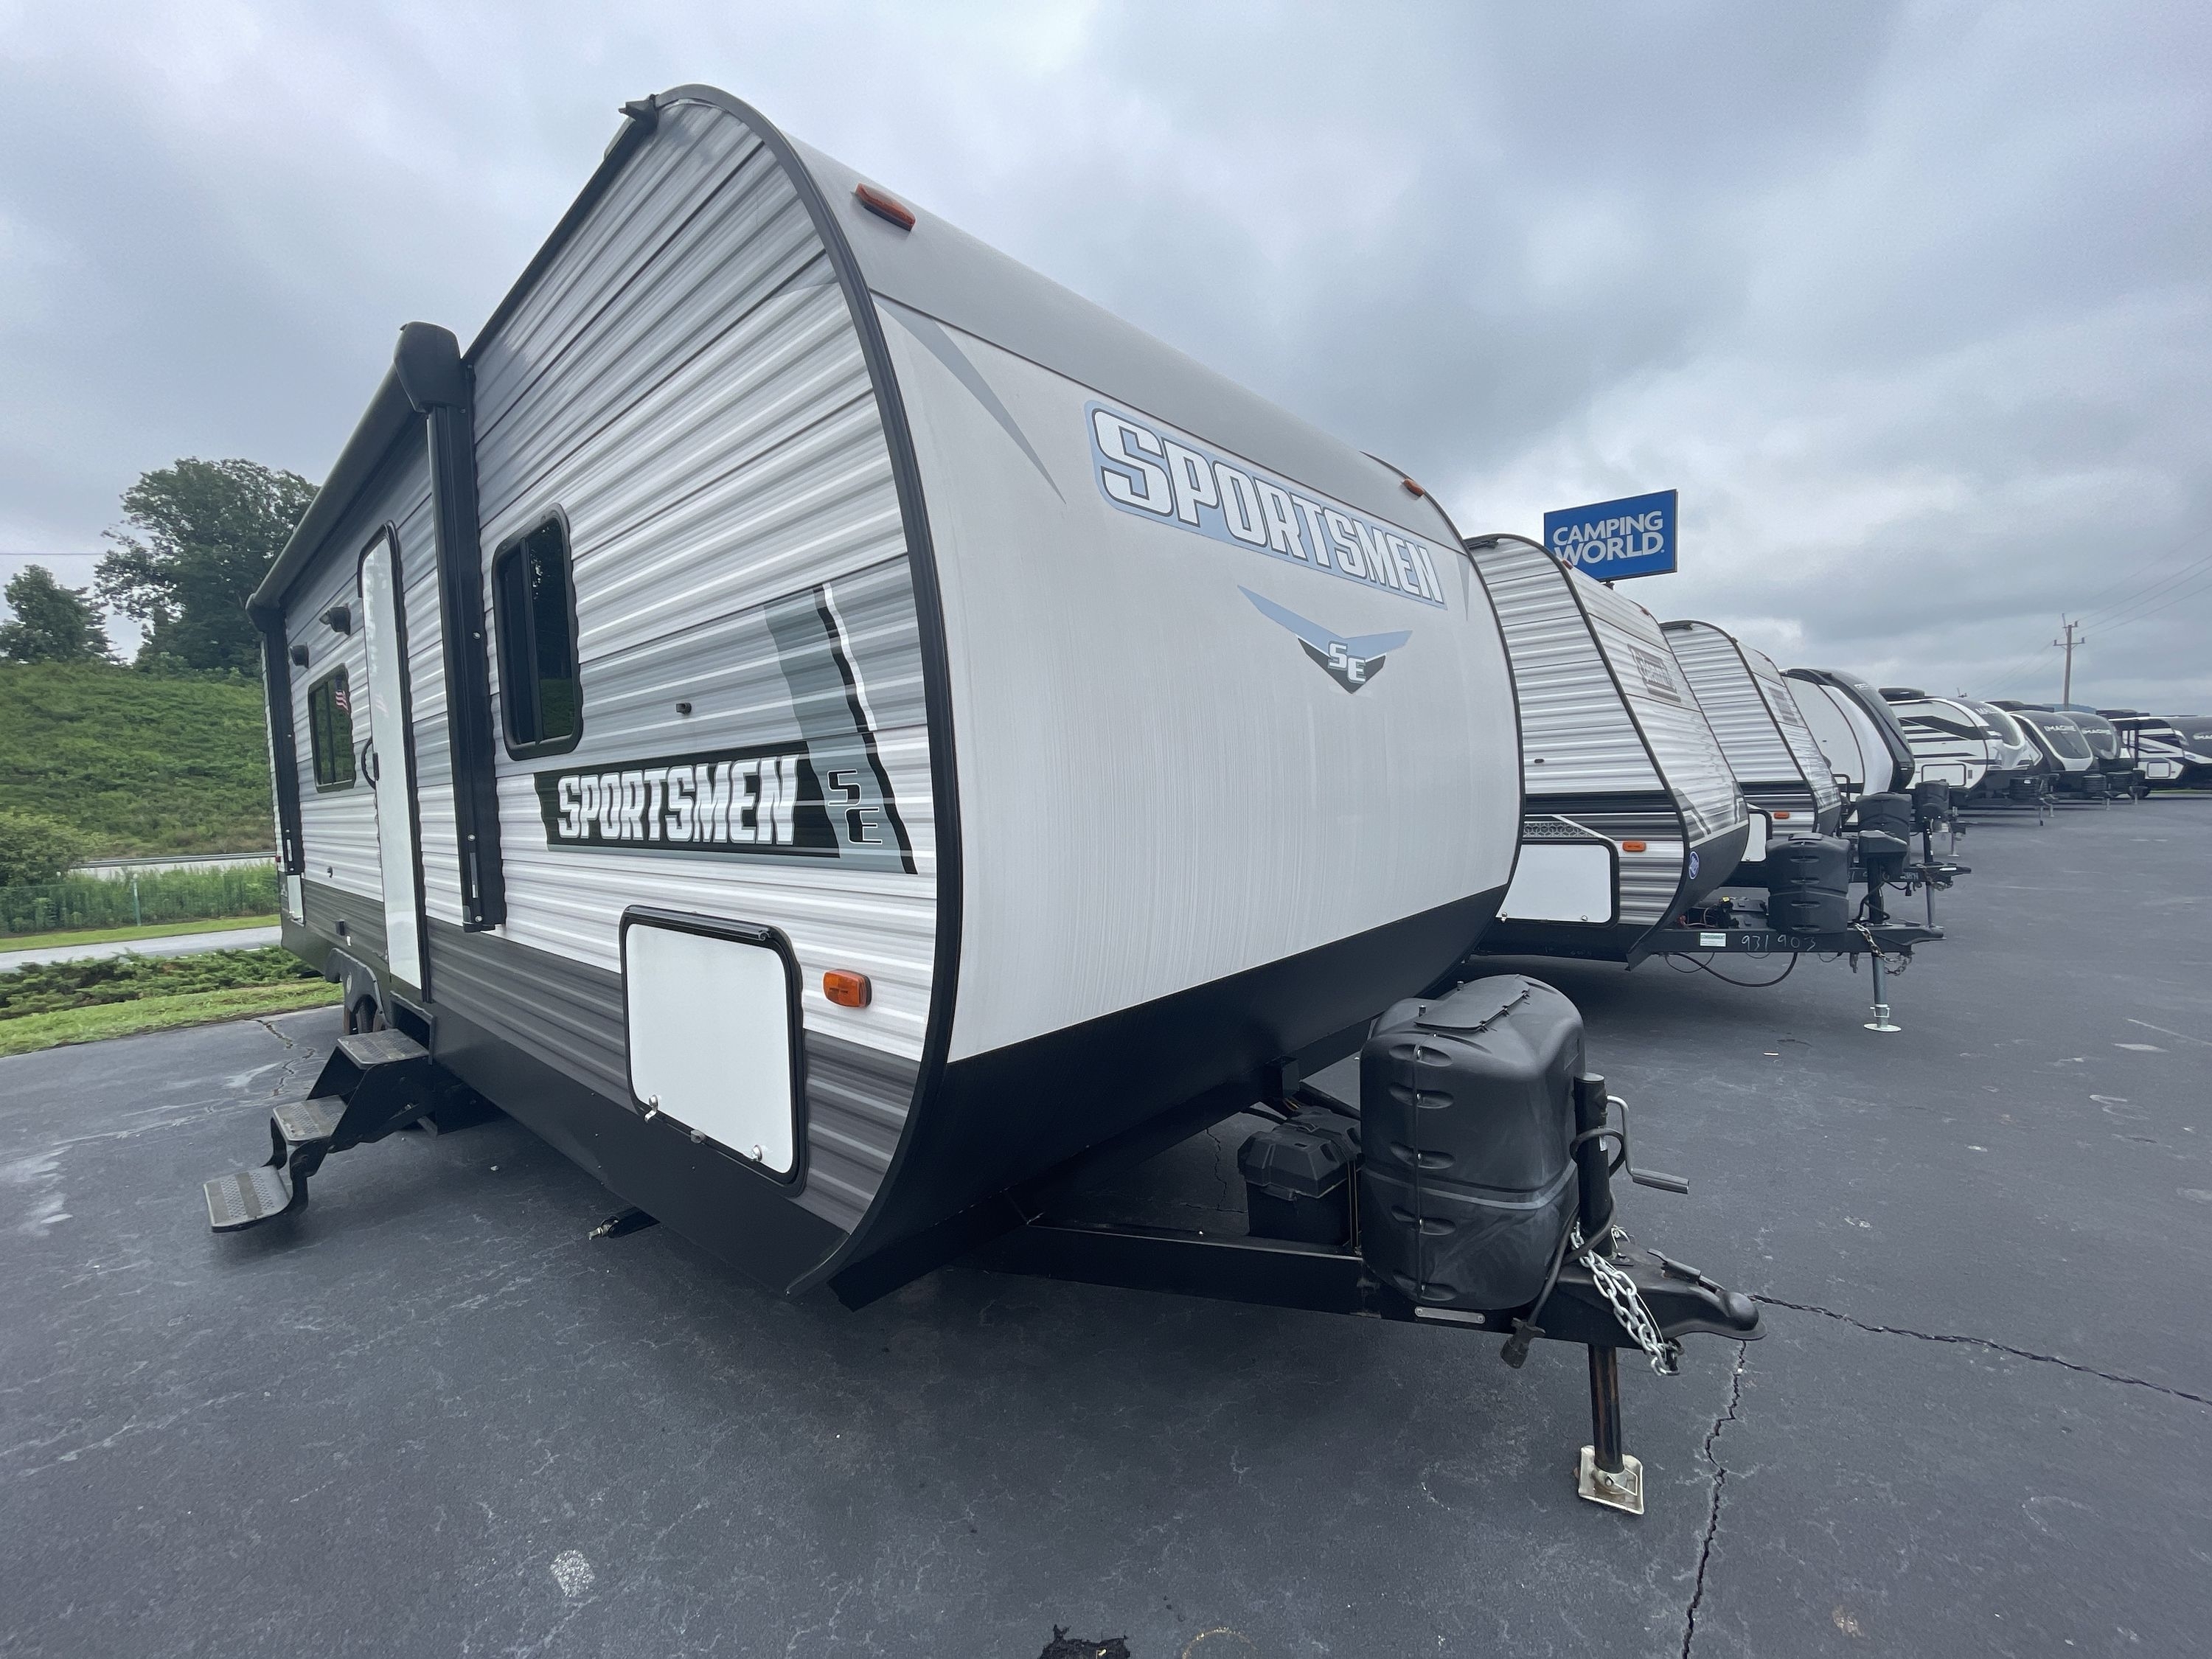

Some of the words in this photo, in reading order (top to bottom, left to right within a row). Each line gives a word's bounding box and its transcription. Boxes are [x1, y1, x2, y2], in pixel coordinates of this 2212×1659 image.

[1092, 408, 1445, 605] SPORTSMEN
[1553, 510, 1663, 546] CAMPING
[1554, 532, 1664, 566] WORLD
[1329, 641, 1366, 684] SE
[557, 754, 799, 846] SPORTSMEN
[827, 769, 883, 845] SE
